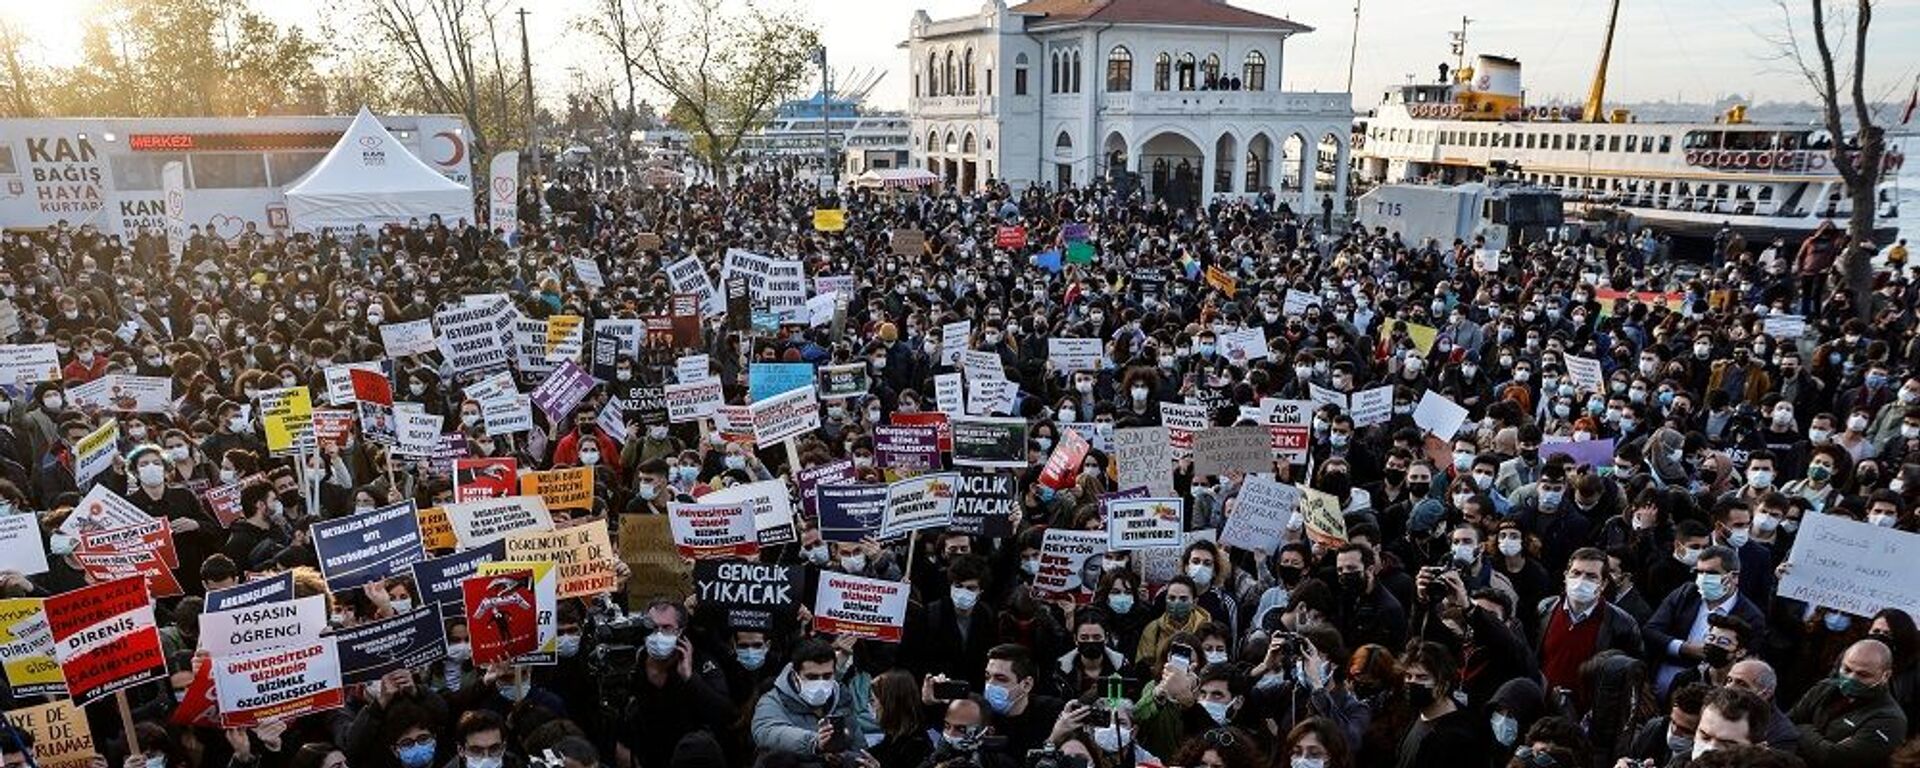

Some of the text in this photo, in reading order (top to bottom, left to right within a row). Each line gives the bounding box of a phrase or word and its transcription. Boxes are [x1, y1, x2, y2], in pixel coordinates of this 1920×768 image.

[37, 184, 102, 200] HAYA
[120, 200, 166, 216] KAN
[1377, 201, 1402, 217] T 15
[630, 387, 665, 399] GENÇL
[718, 563, 789, 585] GENÇLİK
[698, 581, 792, 605] YIKACAK
[231, 605, 297, 626] YAŞASIN
[68, 618, 135, 649] DİRENİŞ
[229, 624, 302, 646] ÖĞRENCİ
[227, 645, 324, 675] ÜNİVERSİTELER
[250, 662, 307, 683] BİZİMDİR
[236, 680, 328, 709] ÖZGÜRLEŞECEK
[256, 674, 305, 694] BİZİMLE
